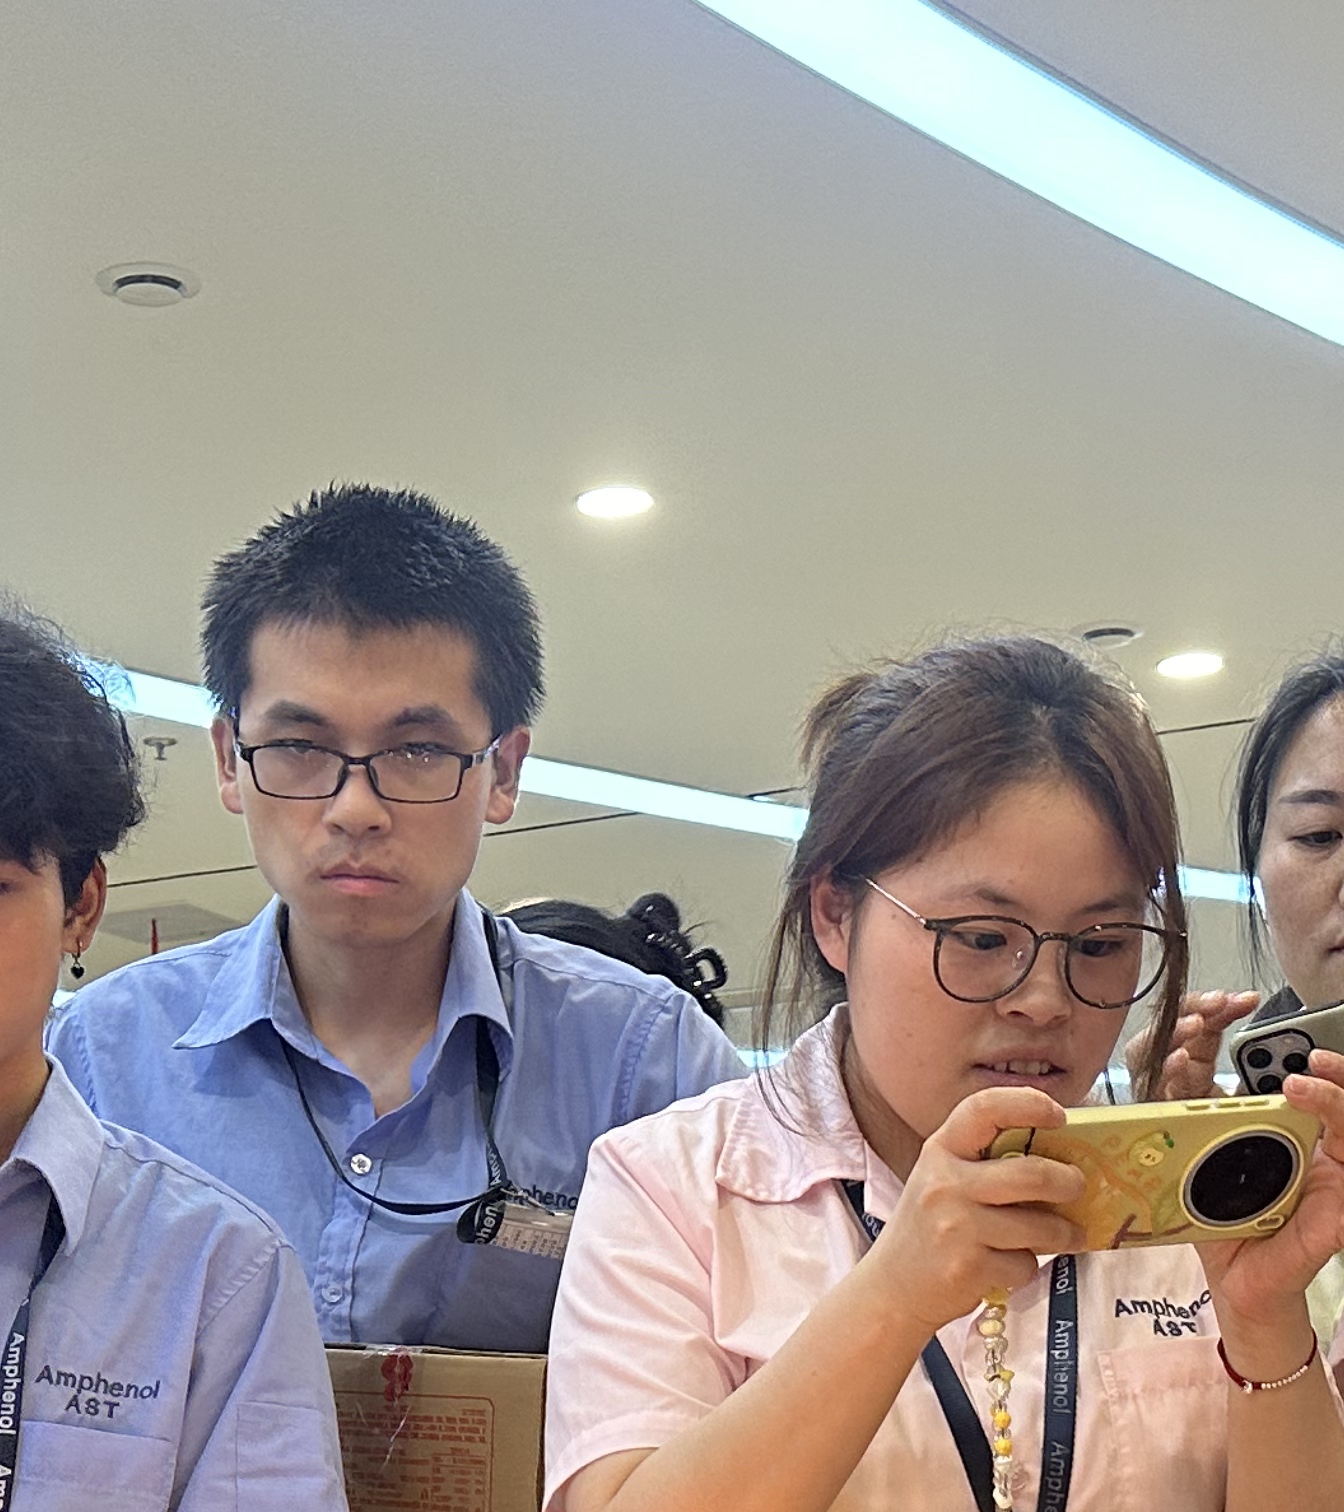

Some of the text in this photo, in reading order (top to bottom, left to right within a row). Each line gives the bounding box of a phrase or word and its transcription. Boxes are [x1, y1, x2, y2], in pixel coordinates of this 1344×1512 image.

[1115, 1290, 1212, 1319] Ampheno
[1153, 1319, 1197, 1337] AST
[34, 1364, 161, 1399] Amphenol
[64, 1395, 120, 1419] AST
